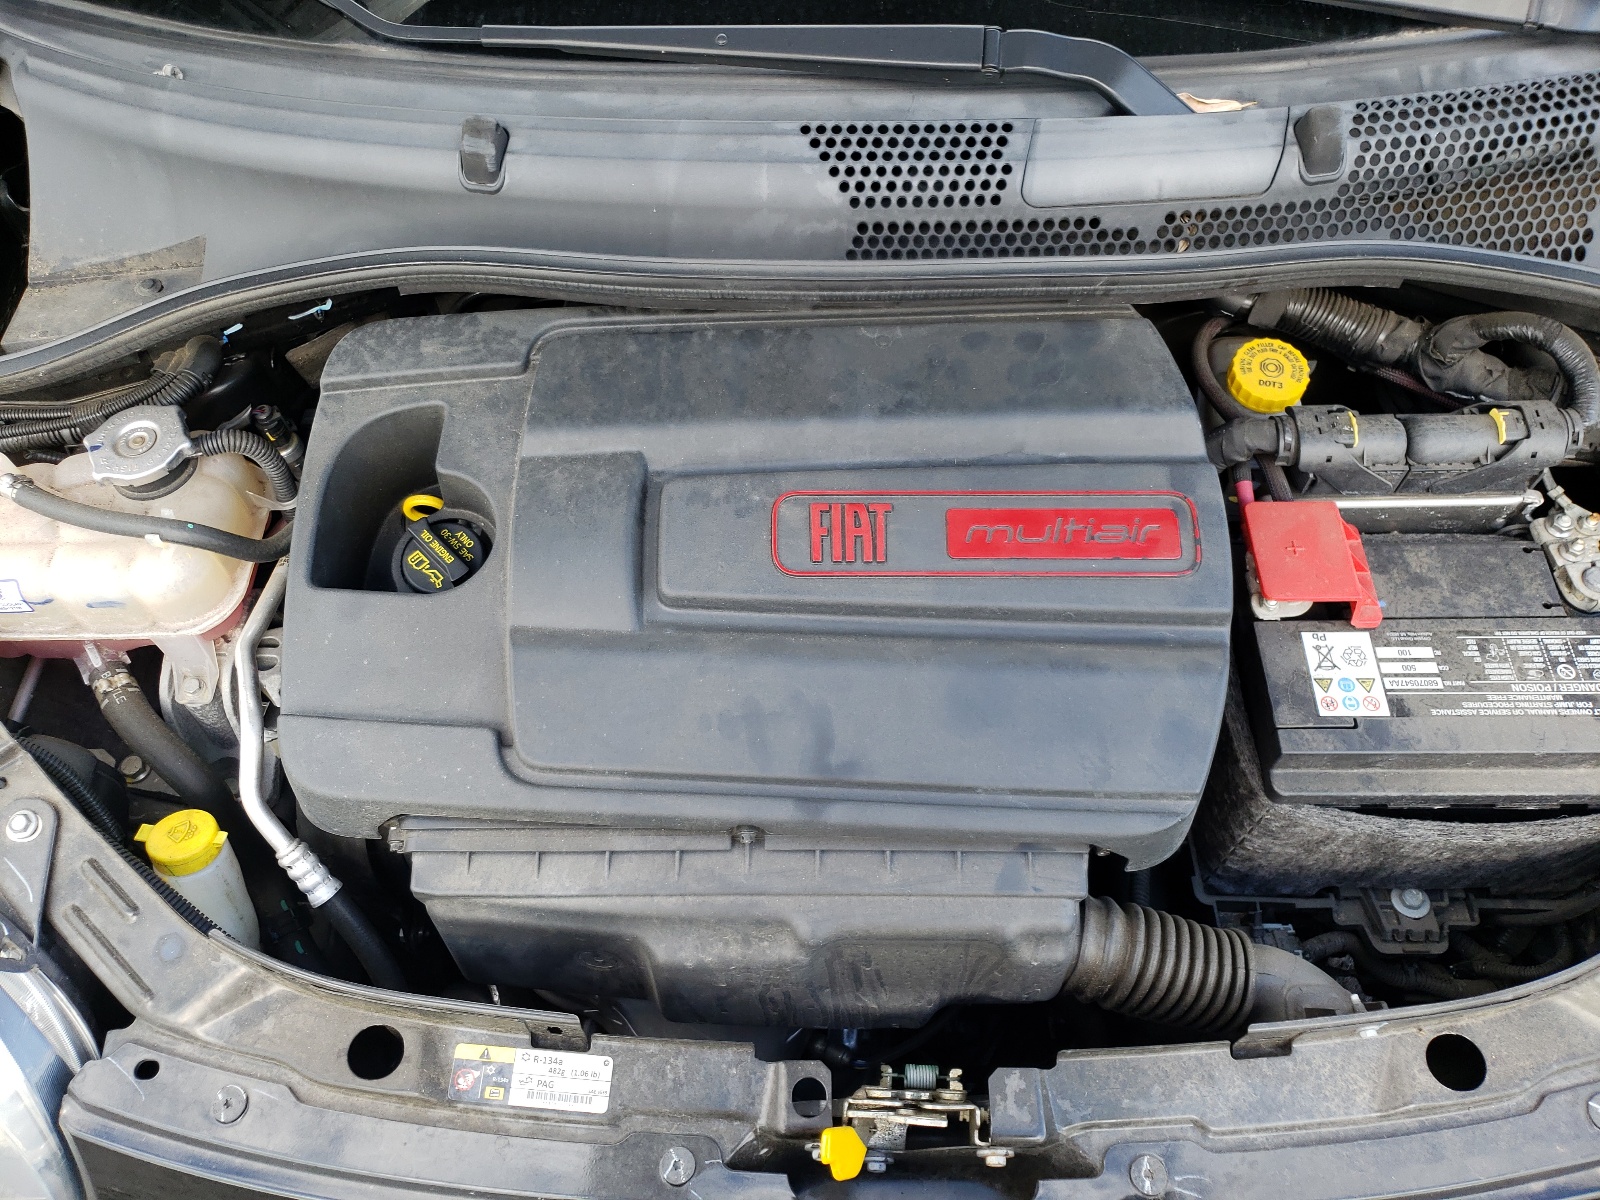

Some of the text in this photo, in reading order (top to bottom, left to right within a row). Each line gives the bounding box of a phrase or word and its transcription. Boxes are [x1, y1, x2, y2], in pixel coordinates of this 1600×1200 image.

[1259, 380, 1283, 389] DOT3
[808, 502, 893, 564] FIAT
[964, 517, 1162, 544] multiair
[440, 528, 474, 562] SAE 5W-30
[455, 531, 474, 548] ONLY
[420, 529, 455, 564] ENGINE OIL
[1312, 633, 1326, 641] Pb
[534, 1056, 563, 1066] R-134a
[548, 1068, 565, 1076] 482g
[571, 1069, 589, 1077] (1.06
[537, 1080, 554, 1089] PAG
